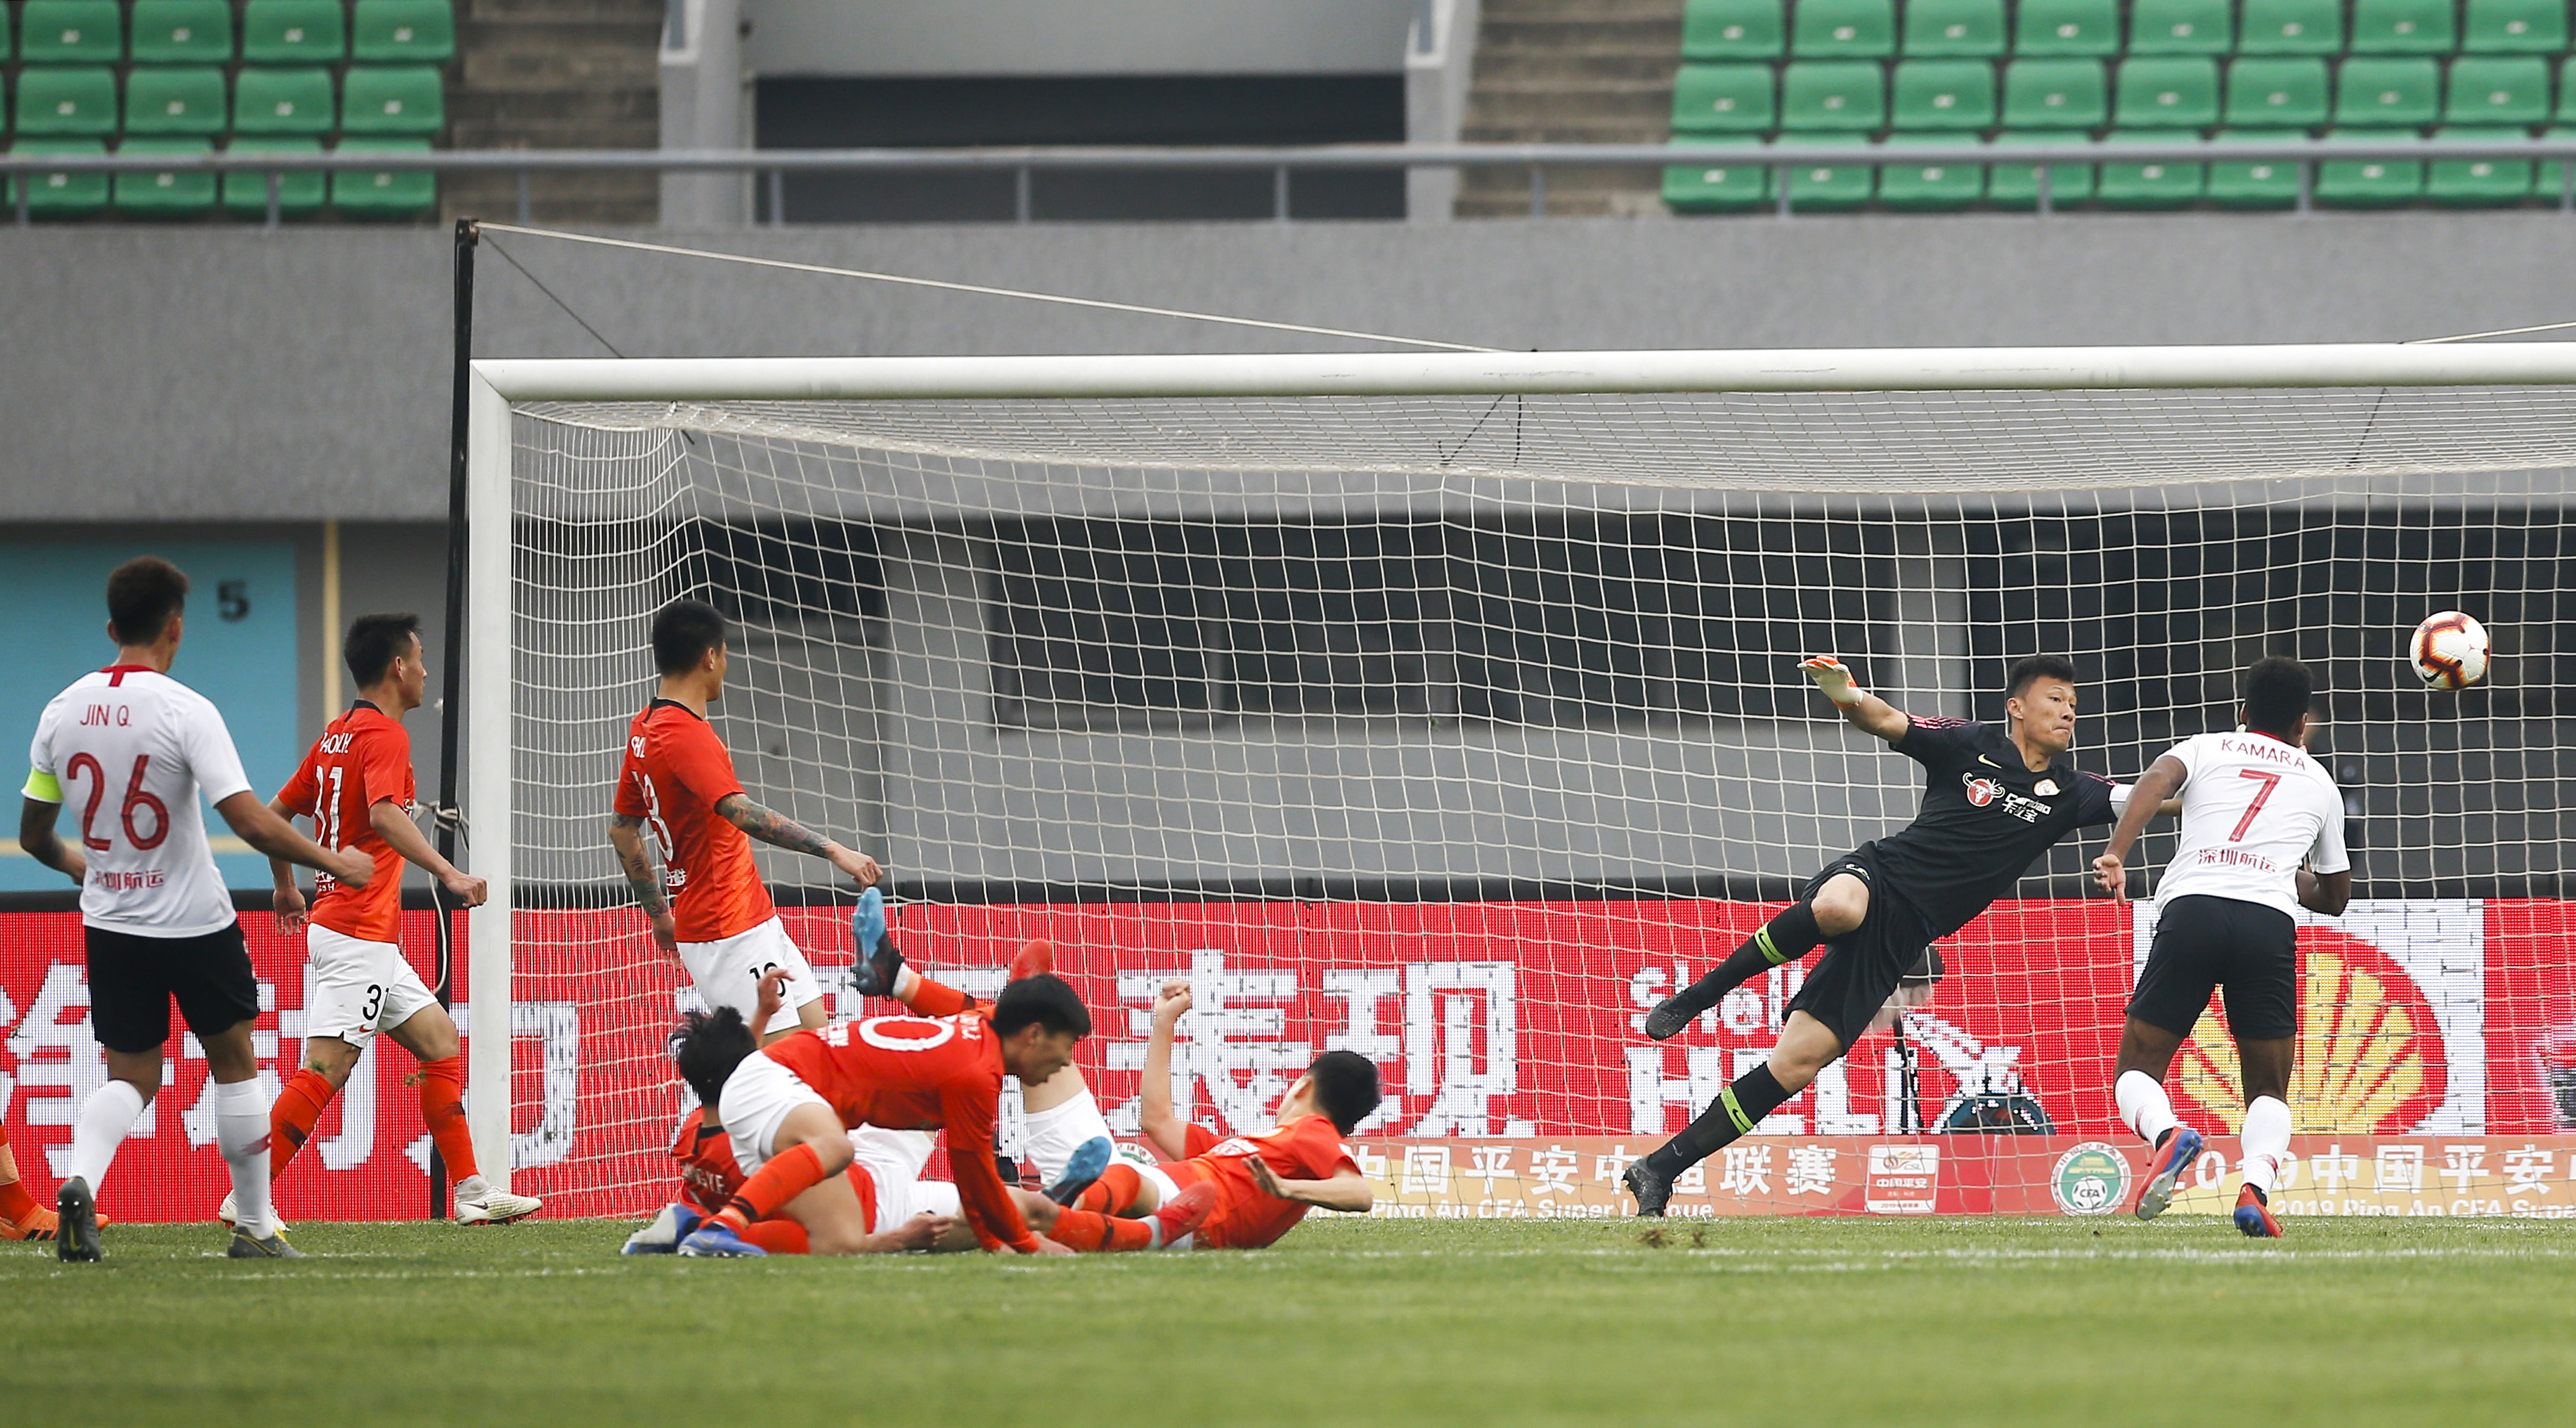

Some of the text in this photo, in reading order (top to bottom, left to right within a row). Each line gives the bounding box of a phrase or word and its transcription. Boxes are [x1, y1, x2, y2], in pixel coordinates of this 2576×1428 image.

[218, 581, 249, 622] 5
[80, 705, 109, 726] JIN
[2222, 739, 2305, 771] KAMARA
[67, 752, 169, 851] 26
[2228, 768, 2282, 842] 7
[2198, 849, 2277, 874] 深圳航运
[2080, 1188, 2100, 1197] CFA
[1372, 1199, 1427, 1219] Ping
[1441, 1200, 1469, 1219] An
[1477, 1199, 1528, 1219] CFA
[1537, 1199, 1614, 1219] Super
[2275, 1199, 2334, 1216] 2019
[2343, 1199, 2400, 1216] Ping
[2408, 1200, 2443, 1216] An
[2451, 1199, 2505, 1217] CFA
